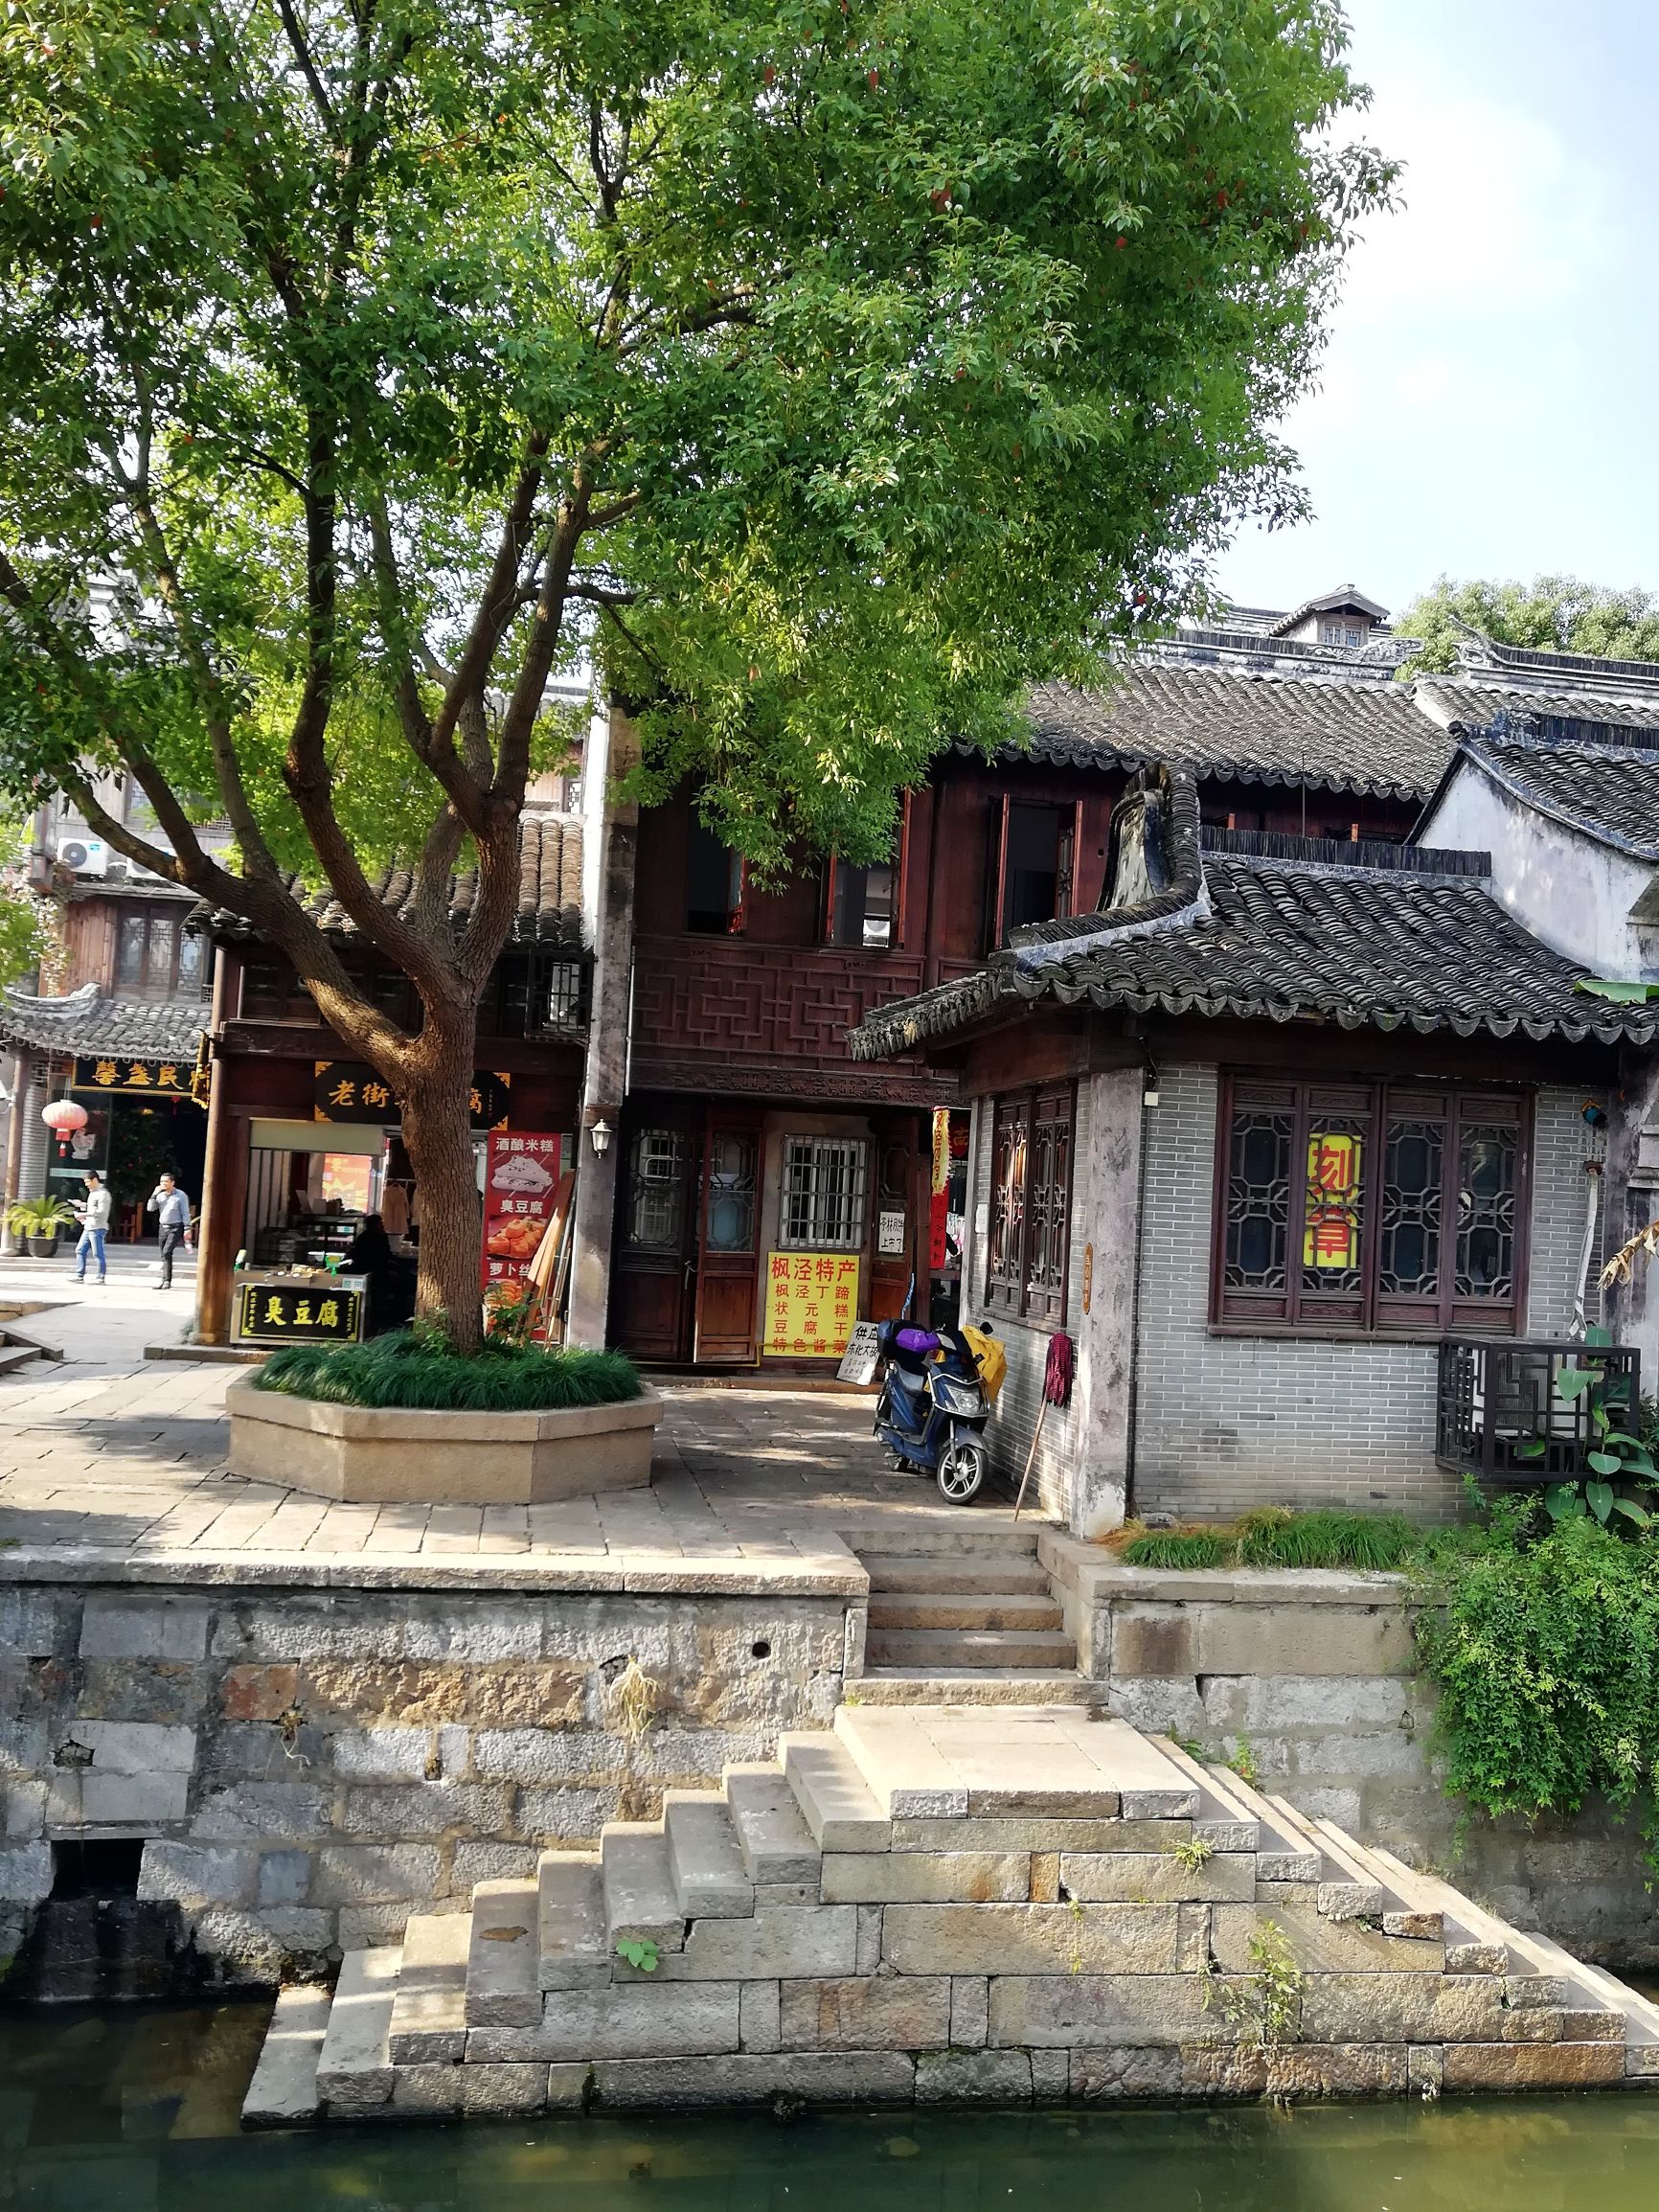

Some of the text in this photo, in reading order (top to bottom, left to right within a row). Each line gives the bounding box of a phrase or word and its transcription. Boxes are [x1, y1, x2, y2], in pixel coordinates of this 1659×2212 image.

[495, 1137, 554, 1152] 酒酿米糕
[500, 1199, 544, 1215] 臭豆腐
[1308, 1145, 1352, 1258] 刻章
[881, 1237, 902, 1253] 上市了
[772, 1256, 856, 1282] 枫泾特产
[775, 1284, 850, 1300] 枫泾丁蹄
[263, 1295, 339, 1328] 臭豆腐
[775, 1301, 849, 1318] 状元糕
[774, 1319, 848, 1336] 豆腐干
[772, 1336, 847, 1354] 特色酱菜
